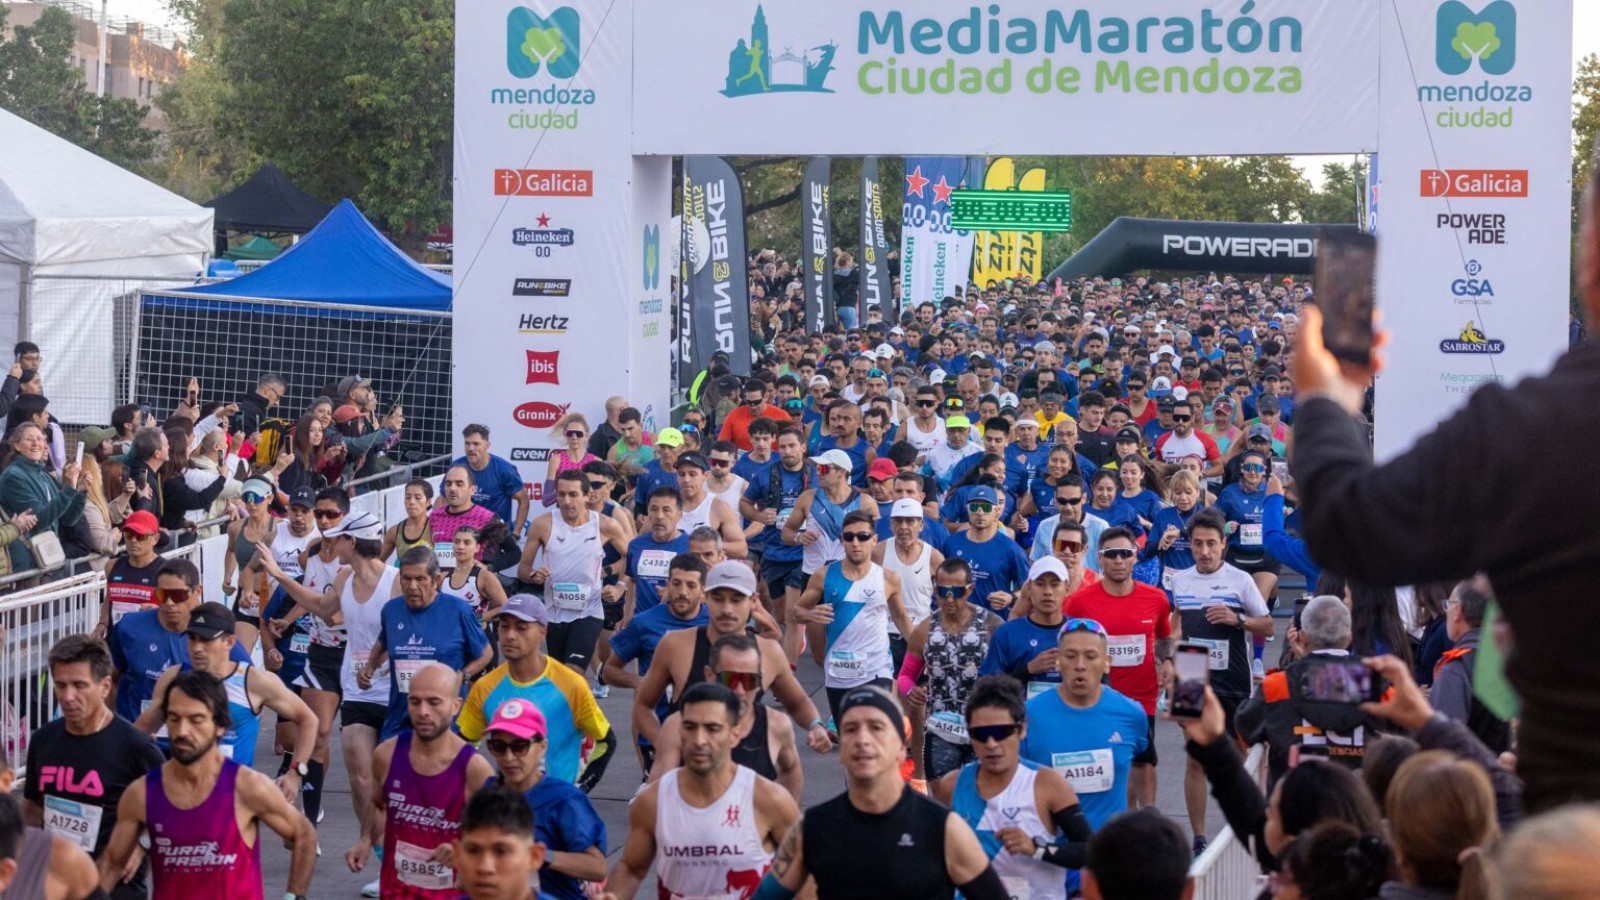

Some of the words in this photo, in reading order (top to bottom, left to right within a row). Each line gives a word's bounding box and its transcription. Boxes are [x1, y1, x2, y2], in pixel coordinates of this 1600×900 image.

[857, 0, 1302, 54] MediaMaratón
[857, 56, 1012, 95] Ciudad
[1025, 57, 1081, 94] de
[1095, 57, 1302, 94] Mendoza
[491, 84, 596, 104] mendoza
[1418, 80, 1532, 102] mendoza
[508, 109, 578, 129] ciudad
[1436, 106, 1513, 128] ciudad
[525, 174, 587, 193] Galicia
[1455, 174, 1522, 192] Galicia
[1437, 214, 1505, 229] POWER
[516, 231, 571, 242] Heineken
[1468, 229, 1505, 244] ADE
[1451, 279, 1494, 296] GSA
[519, 314, 569, 330] Hertz
[531, 360, 555, 374] ibis
[517, 409, 556, 420] Granix
[642, 559, 670, 567] C4382
[558, 592, 586, 601] A1058
[1108, 646, 1140, 655] B3196
[833, 661, 862, 669] A1087
[935, 722, 965, 735] A1441
[1065, 765, 1104, 779] A1184
[39, 766, 104, 797] FILA
[50, 814, 89, 833] A1728
[664, 845, 744, 857] UMBRAL
